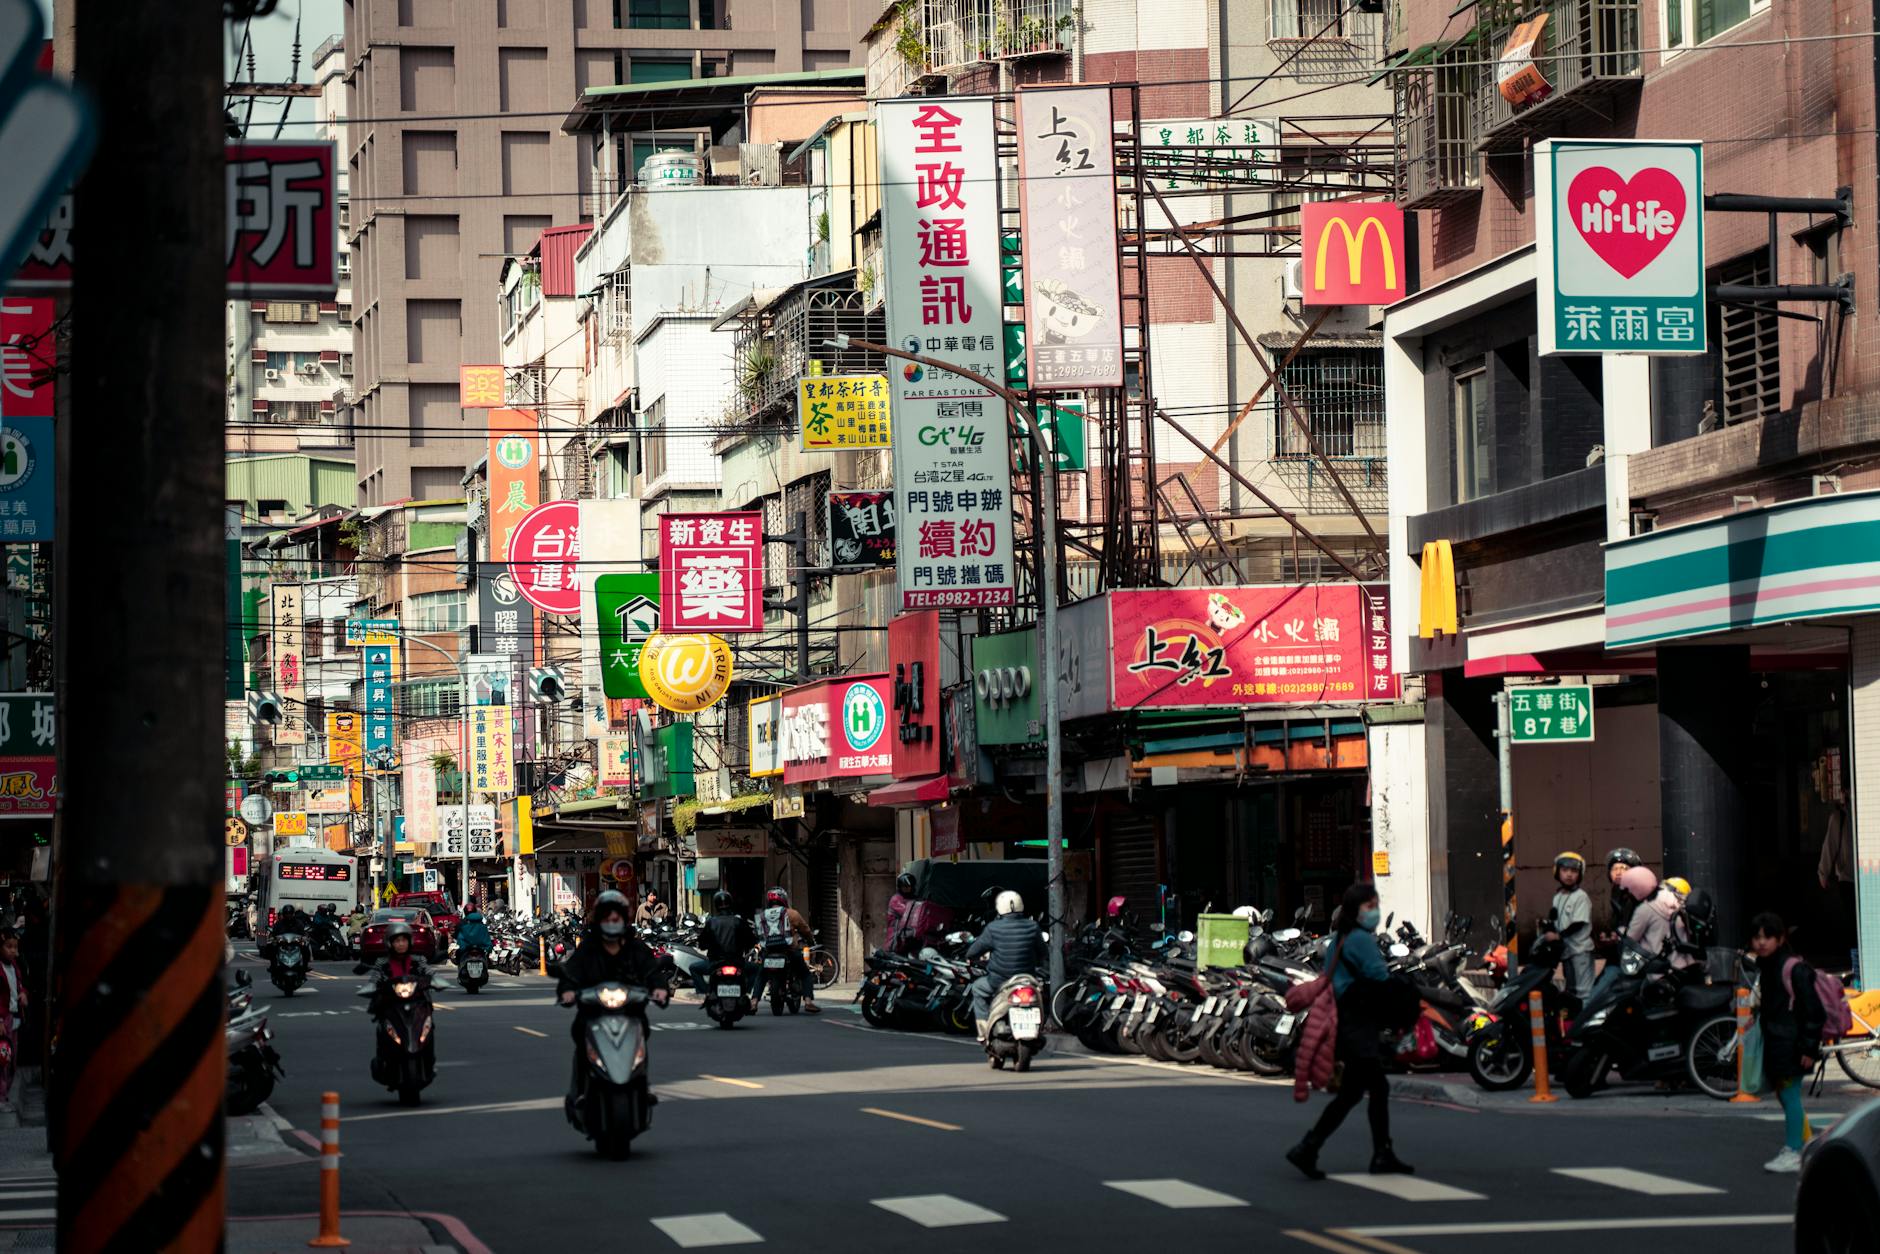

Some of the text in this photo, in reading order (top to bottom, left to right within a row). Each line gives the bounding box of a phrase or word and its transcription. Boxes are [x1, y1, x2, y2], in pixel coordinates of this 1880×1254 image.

[1159, 123, 1261, 146] 皇都茶莊
[911, 105, 973, 326] 全政通訊
[1564, 305, 1695, 341] 萊爾富
[926, 335, 994, 353] 中華電信
[805, 379, 890, 399] 皇都茶行普
[929, 388, 983, 396] EASTONE
[806, 402, 834, 436] 茶
[836, 402, 846, 444] 高山茶
[846, 402, 857, 444] 阿里山
[878, 400, 888, 443] 凍頂烏龍
[937, 401, 983, 418] 遠傳
[950, 446, 983, 455] 智慧生活
[908, 489, 1003, 513] 門號申辦
[0, 519, 36, 536] 藥局
[533, 525, 579, 557] 台
[669, 518, 755, 546] 新資生
[919, 518, 996, 559] 續約
[680, 555, 746, 620] 藥
[914, 564, 1004, 586] 門號攜碼
[908, 590, 1010, 607] TEL:8982-1234
[1253, 617, 1340, 643] 小火鍋
[1370, 596, 1389, 691] 三重五華店
[713, 647, 727, 682] TRUE
[1129, 628, 1231, 684] 上紅
[1514, 693, 1576, 712] 五華街
[1524, 716, 1577, 735] 87 巷
